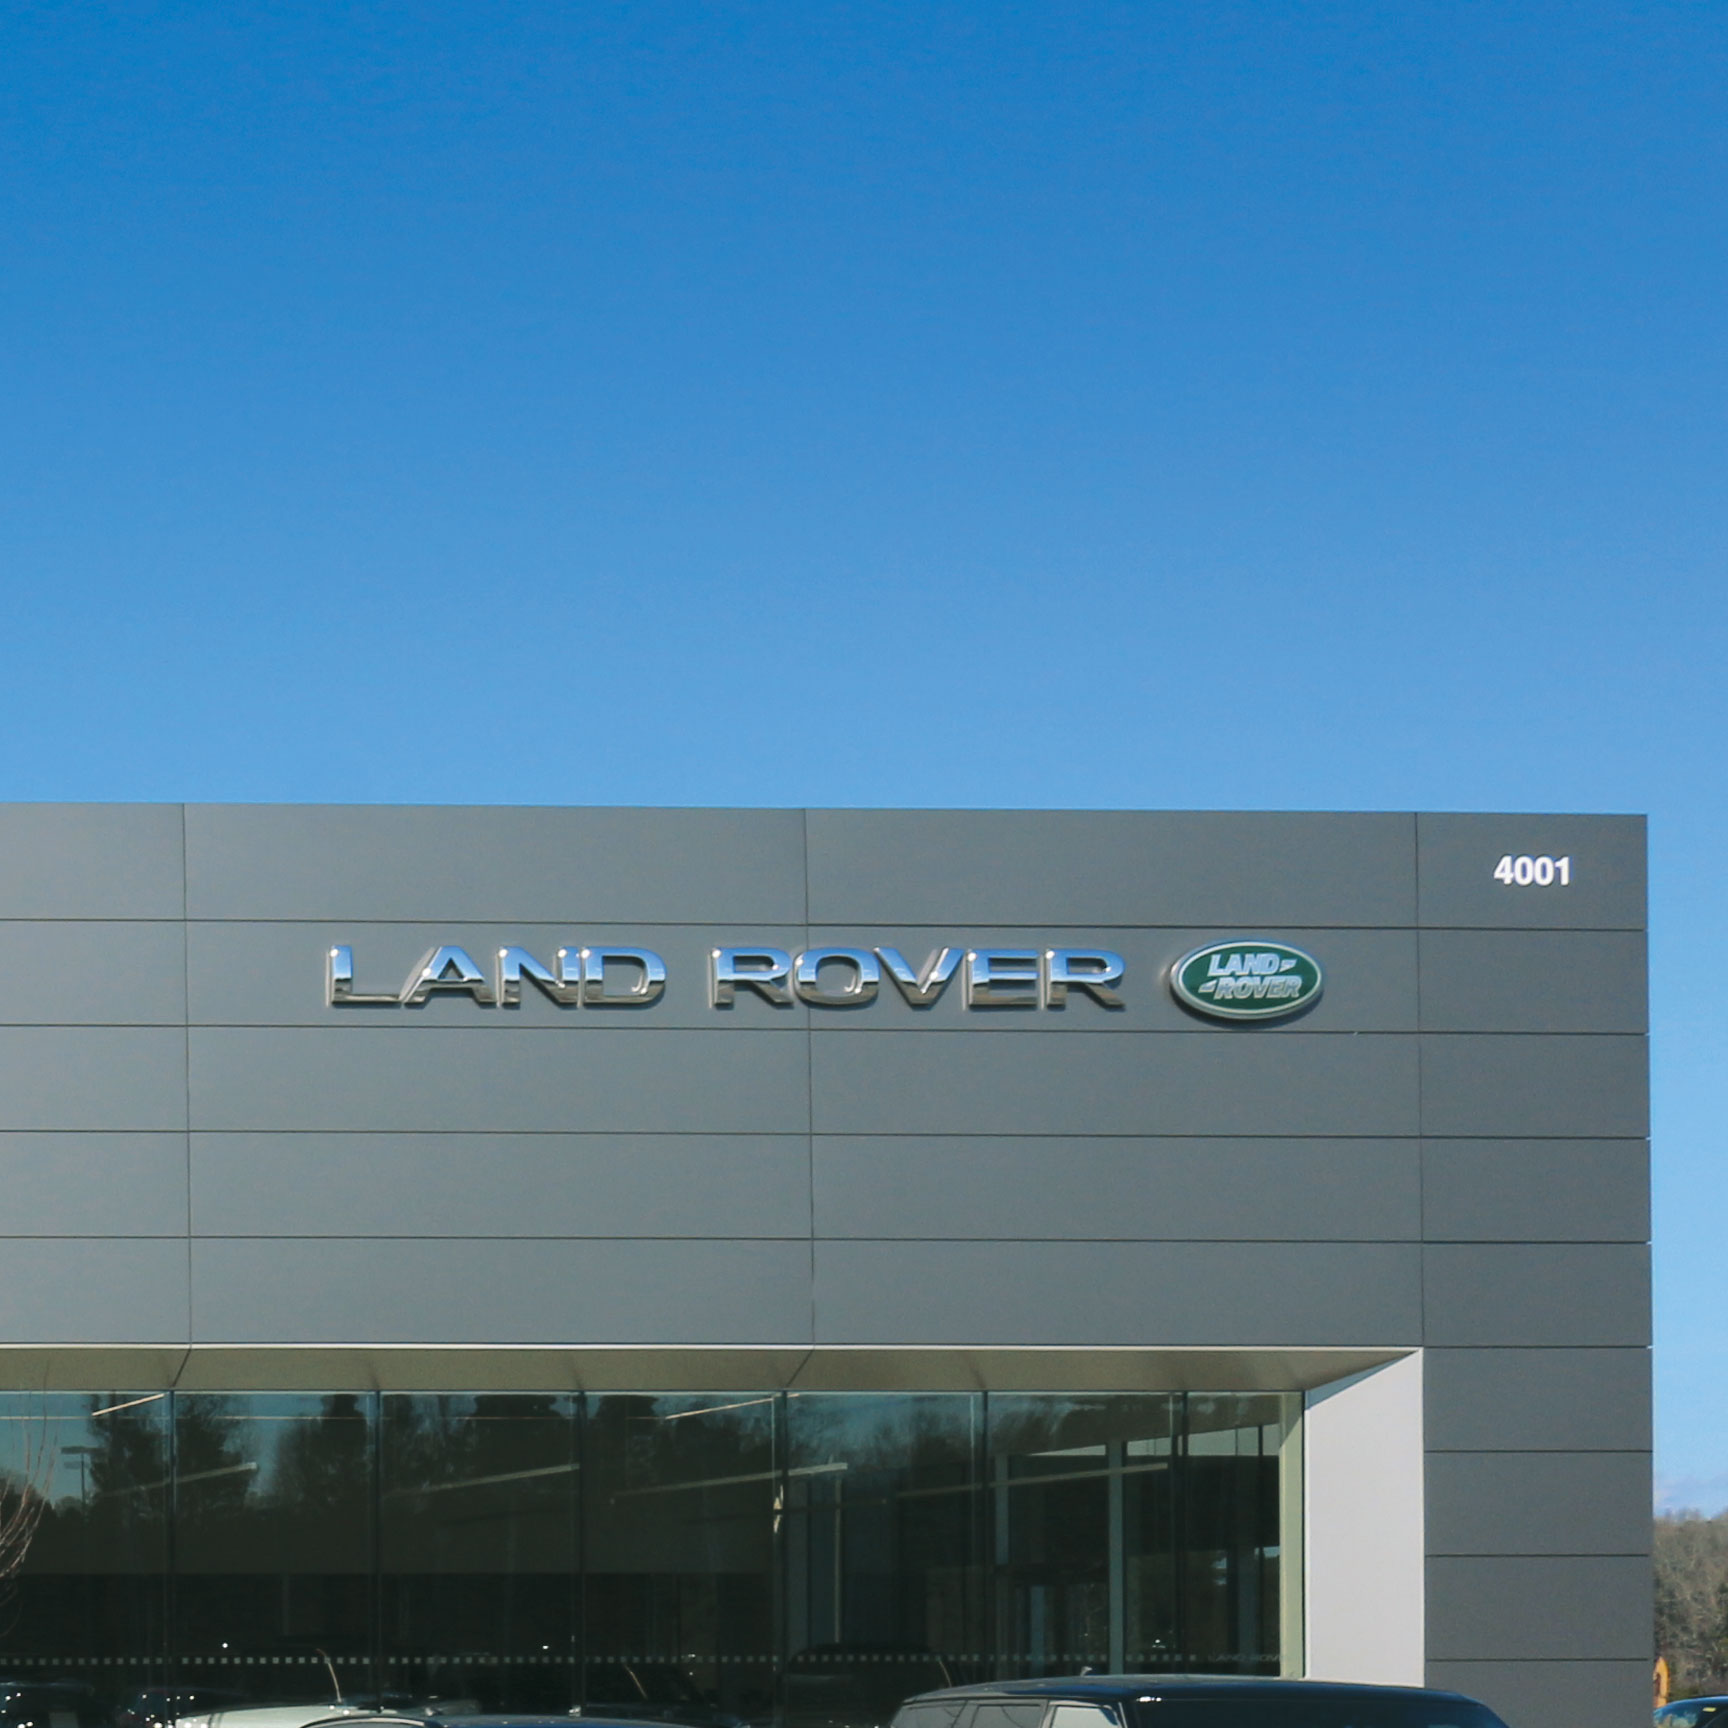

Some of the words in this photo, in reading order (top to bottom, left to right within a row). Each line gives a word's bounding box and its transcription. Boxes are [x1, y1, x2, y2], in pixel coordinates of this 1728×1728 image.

[1493, 855, 1570, 887] 4001
[326, 944, 667, 1008] LAND
[708, 945, 1127, 1010] ROVER
[1207, 953, 1280, 977] LAND
[1213, 975, 1302, 1000] ROVER
